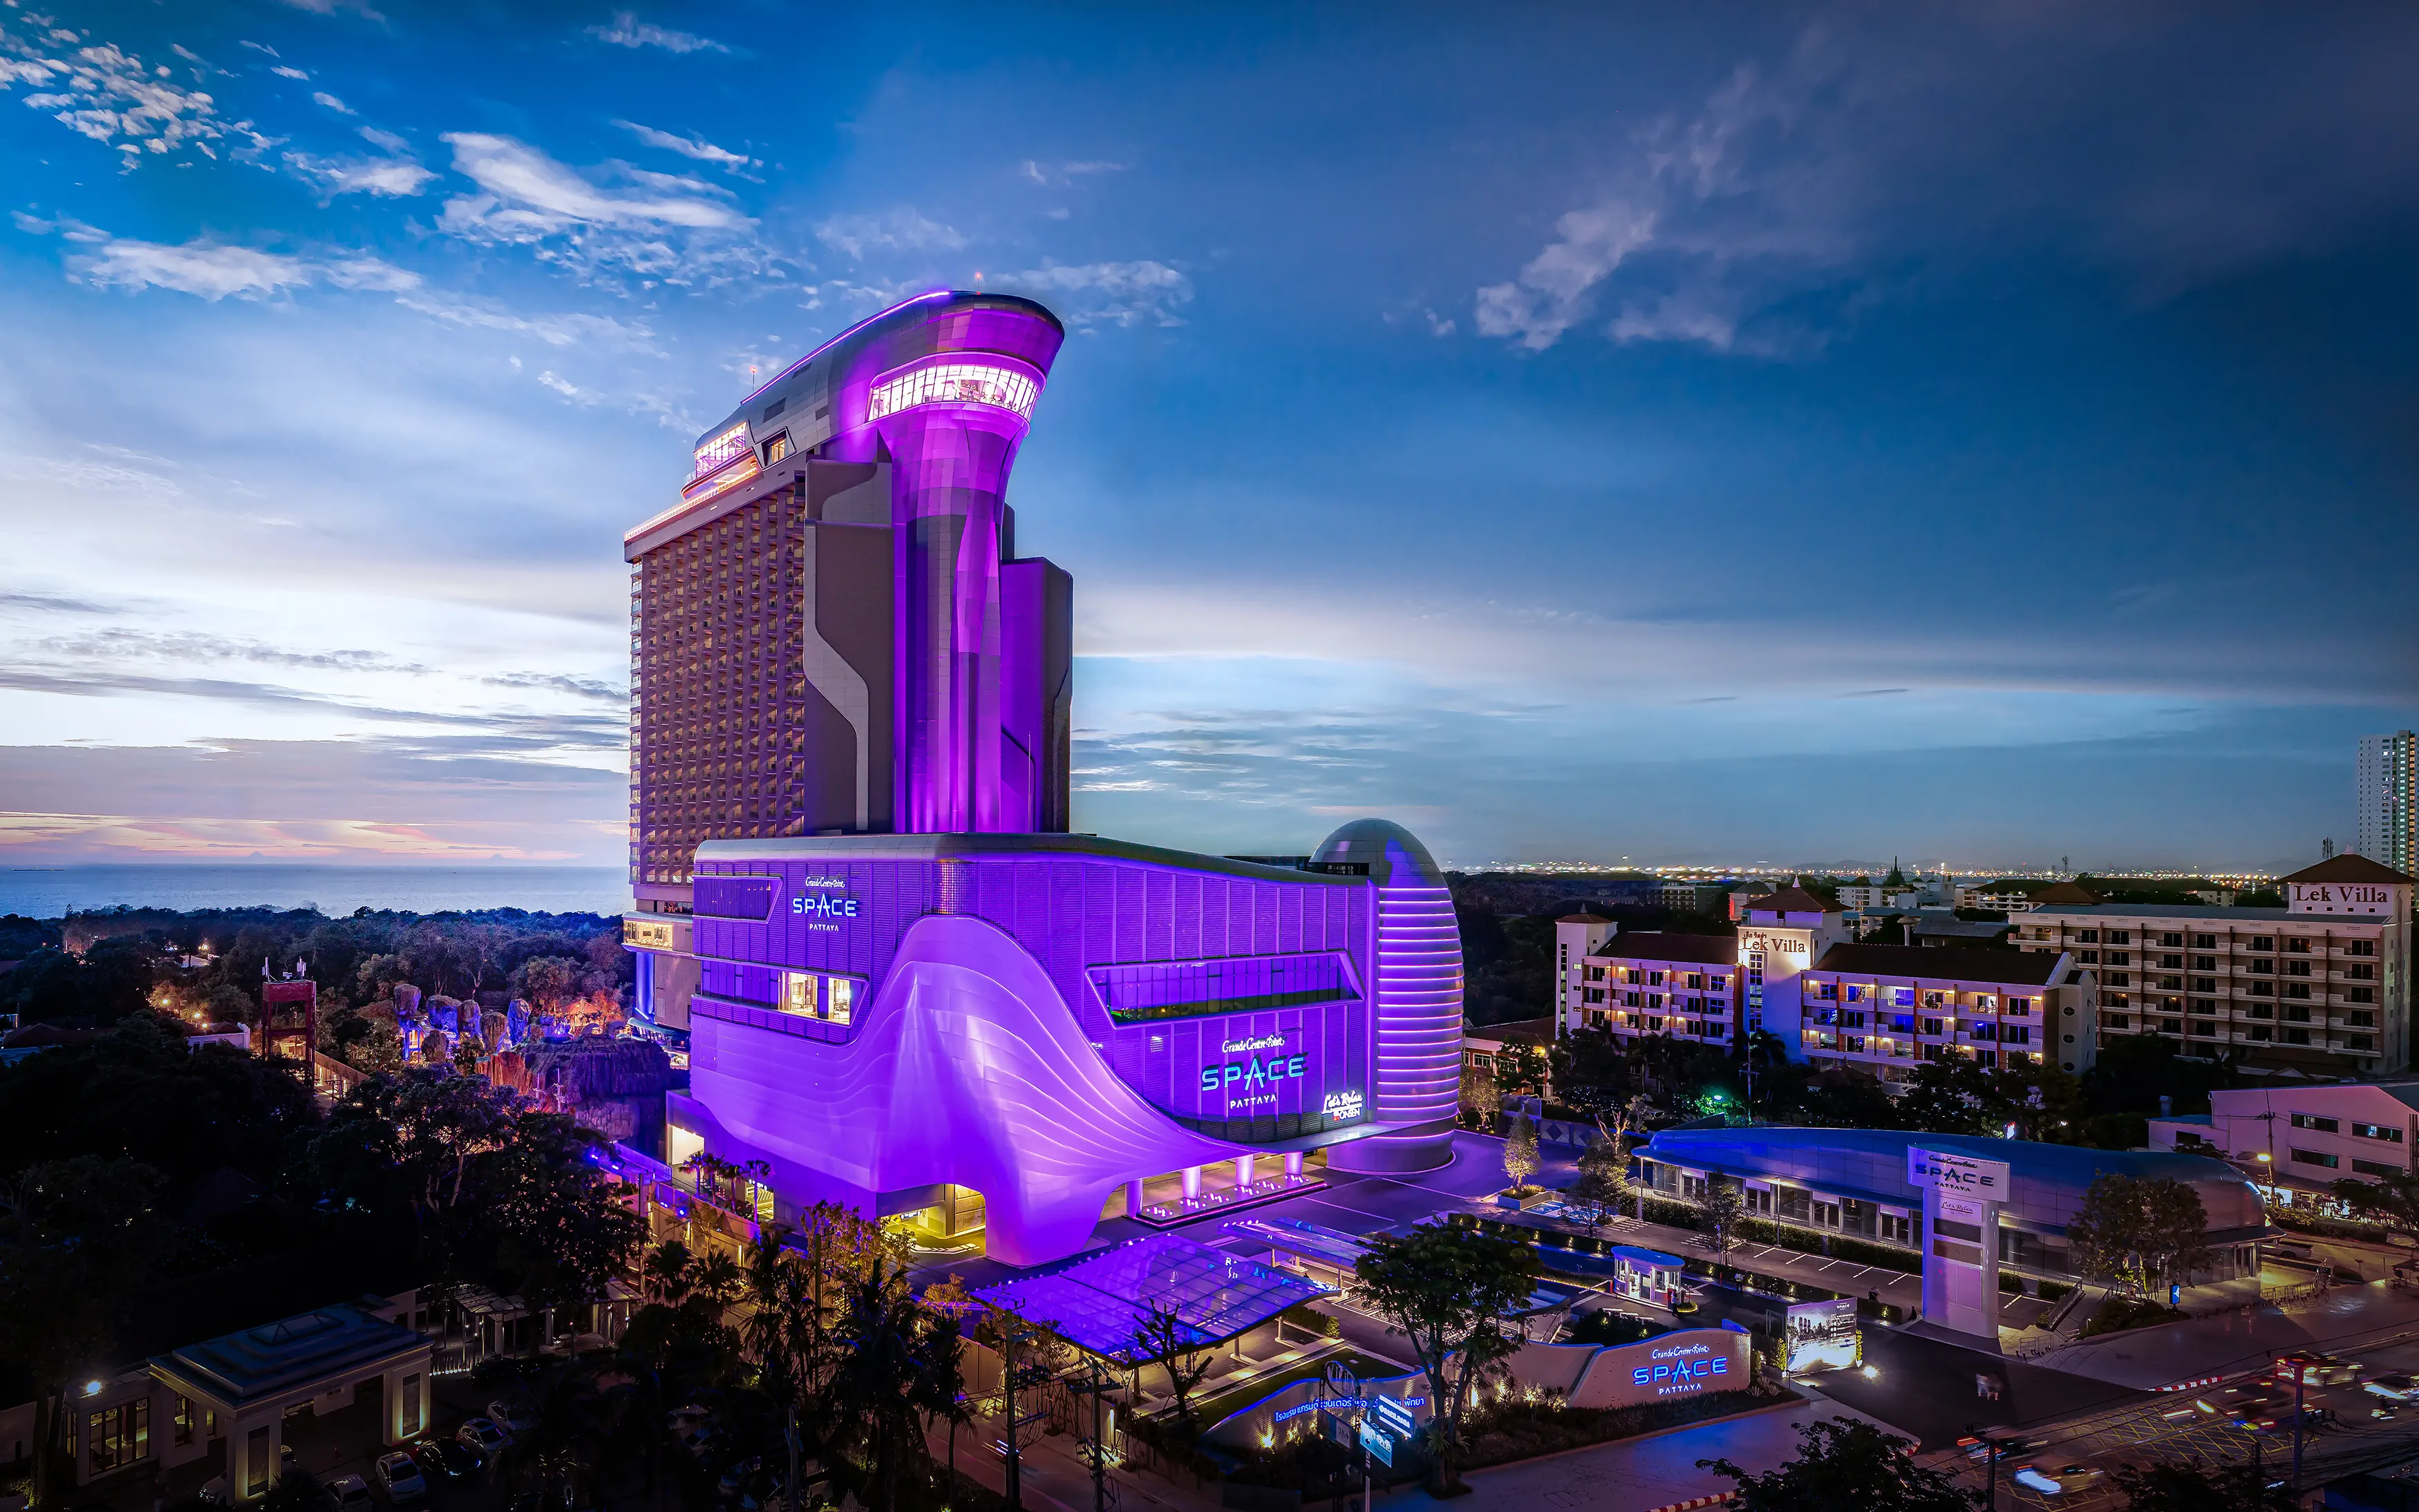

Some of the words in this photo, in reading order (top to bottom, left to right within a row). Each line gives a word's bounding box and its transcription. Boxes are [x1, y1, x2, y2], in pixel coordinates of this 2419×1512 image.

[2294, 885, 2332, 902] Lek
[2337, 886, 2387, 903] Villa
[793, 894, 856, 918] SPACE
[1742, 937, 1769, 951] Lek
[1770, 938, 1805, 953] Villa
[1222, 1039, 1246, 1053] Grande
[1246, 1037, 1265, 1050] Centre
[1202, 1057, 1304, 1091] SPACE
[1230, 1094, 1277, 1109] PATTAYA
[1915, 1164, 1995, 1187] SPACE
[1935, 1182, 1971, 1192] PATTAYA
[1652, 1348, 1674, 1359] Grande
[1674, 1346, 1692, 1357] Centre
[1634, 1357, 1727, 1384] SPACE
[1659, 1383, 1702, 1395] PATTAYA
[1404, 1397, 1424, 1406] พัทยา
